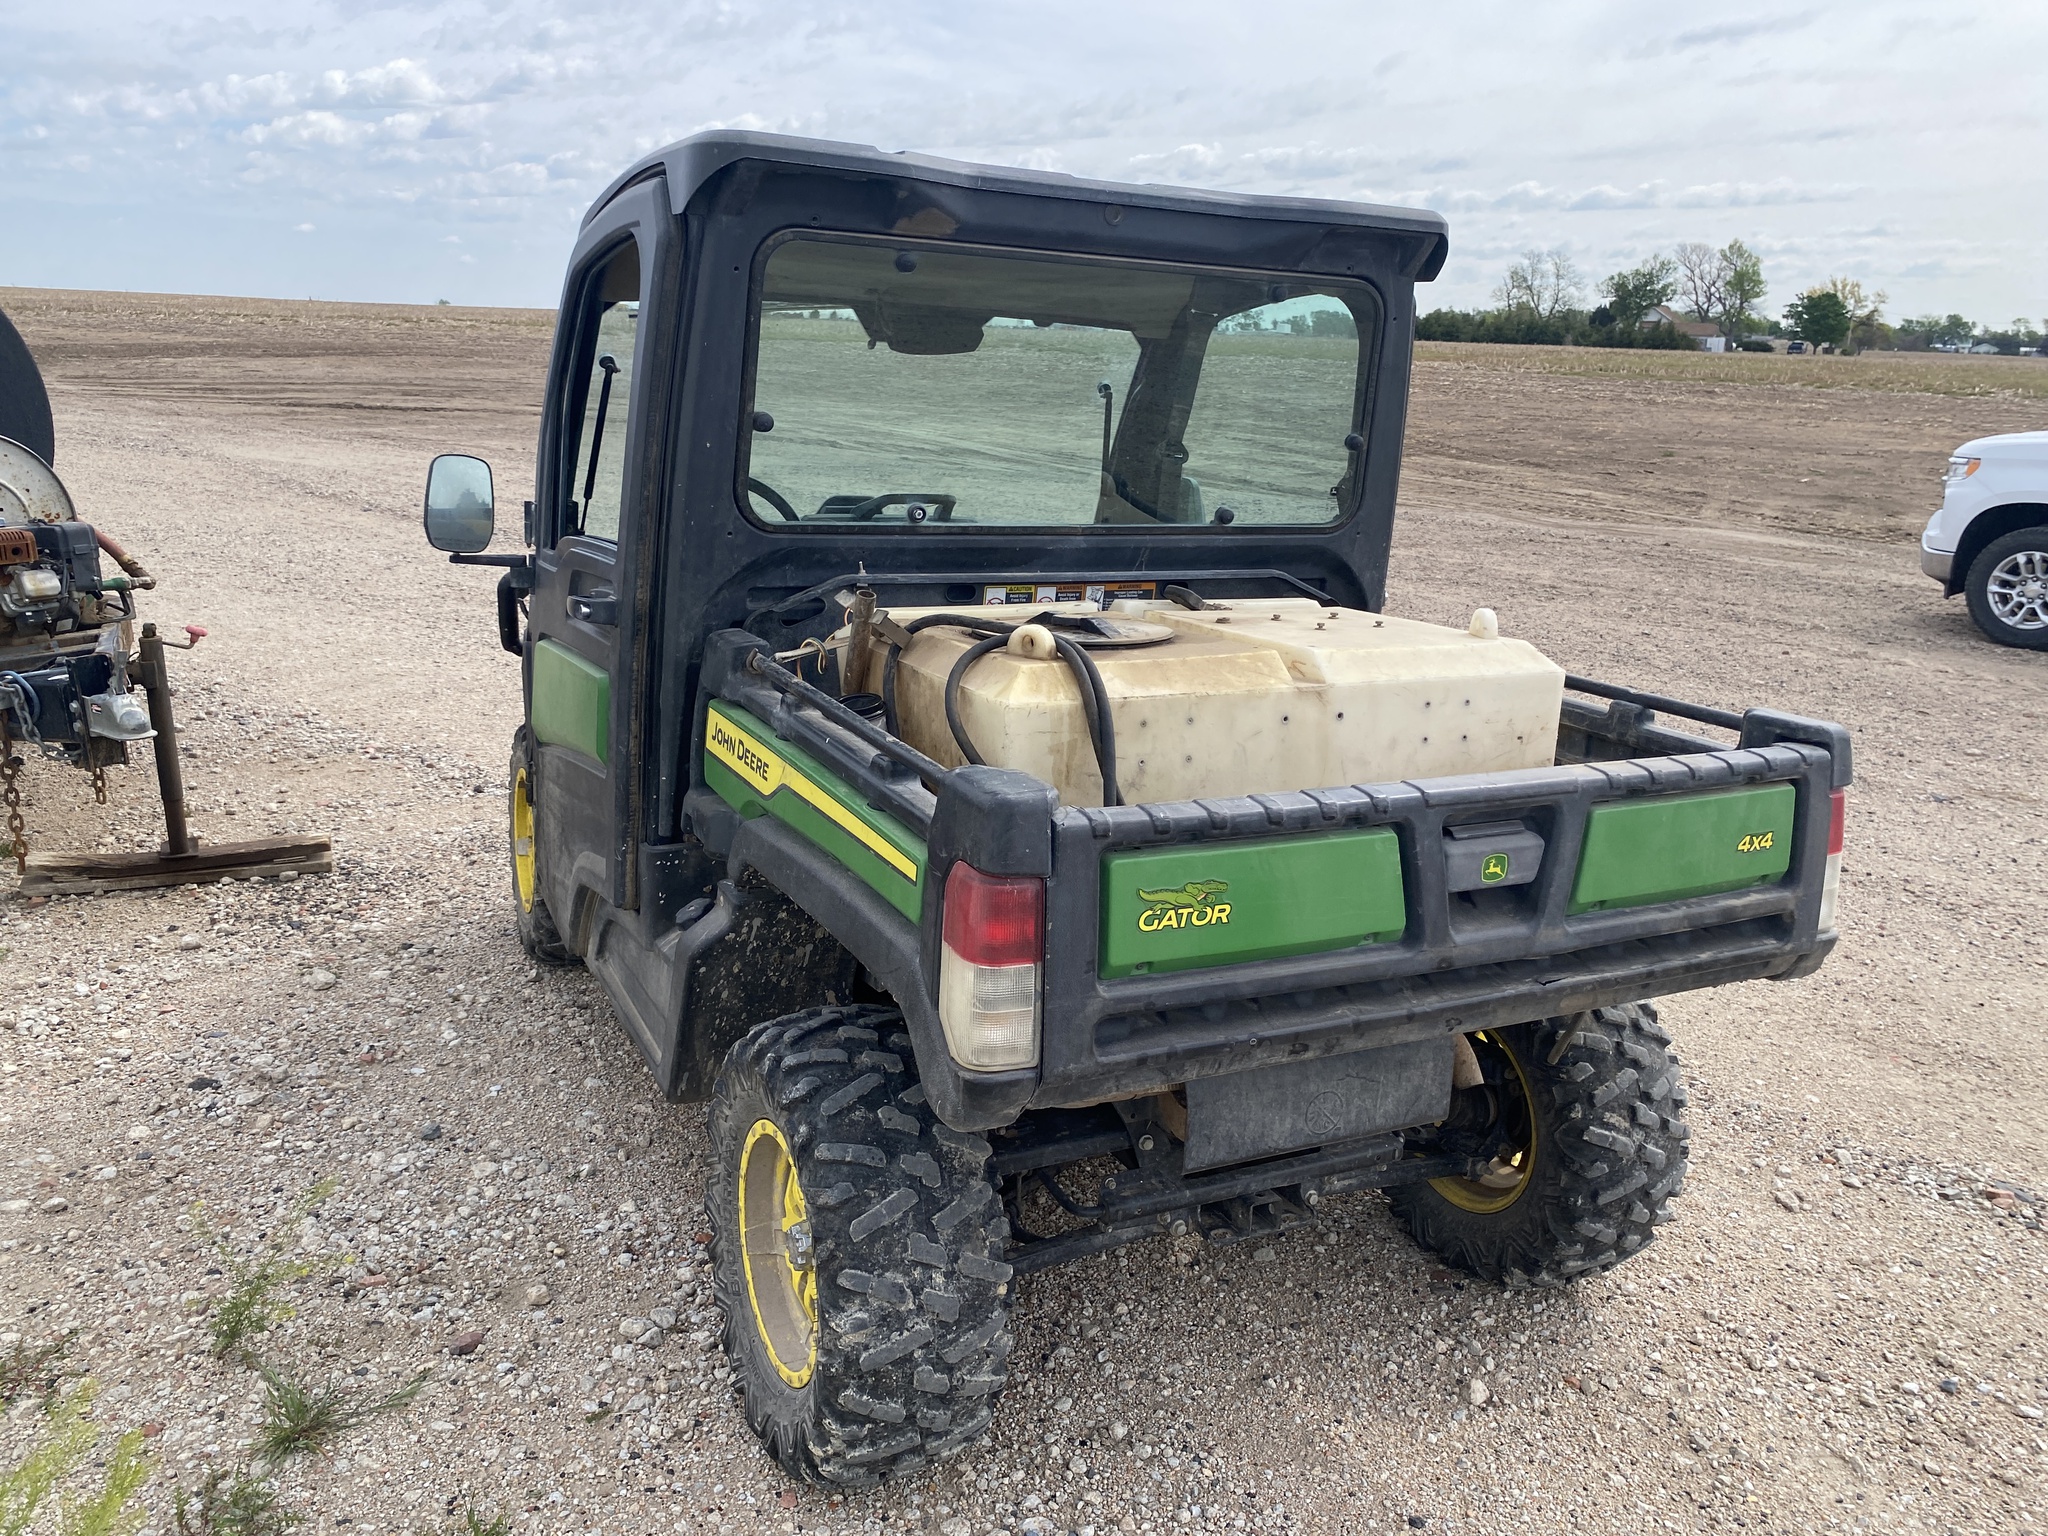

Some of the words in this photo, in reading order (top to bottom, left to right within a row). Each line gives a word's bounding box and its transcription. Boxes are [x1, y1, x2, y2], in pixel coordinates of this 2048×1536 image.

[712, 722, 736, 756] JOHN
[737, 739, 769, 781] DEERE
[1138, 902, 1232, 932] GATOR
